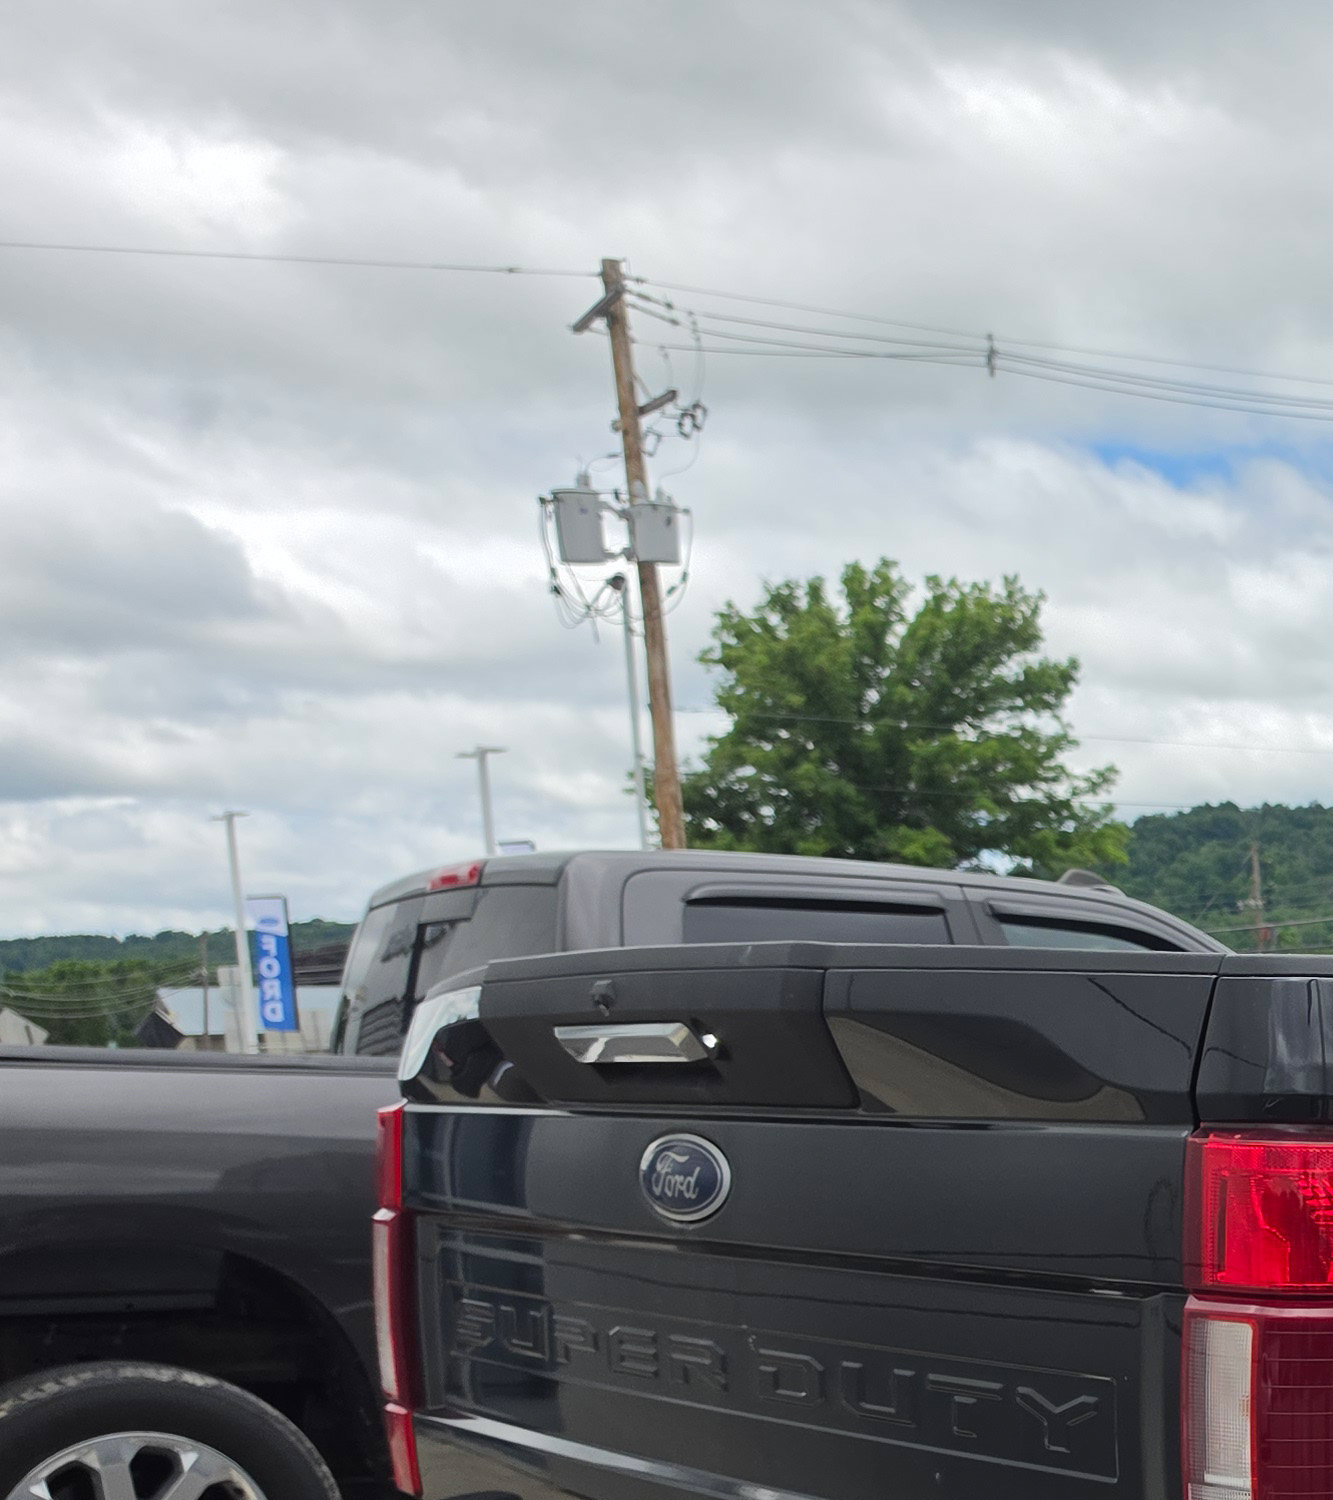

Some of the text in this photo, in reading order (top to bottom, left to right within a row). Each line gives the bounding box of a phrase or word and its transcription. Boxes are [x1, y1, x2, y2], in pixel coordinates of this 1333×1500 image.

[650, 1148, 700, 1200] Ford
[454, 1298, 1098, 1454] SUPER DUTY
